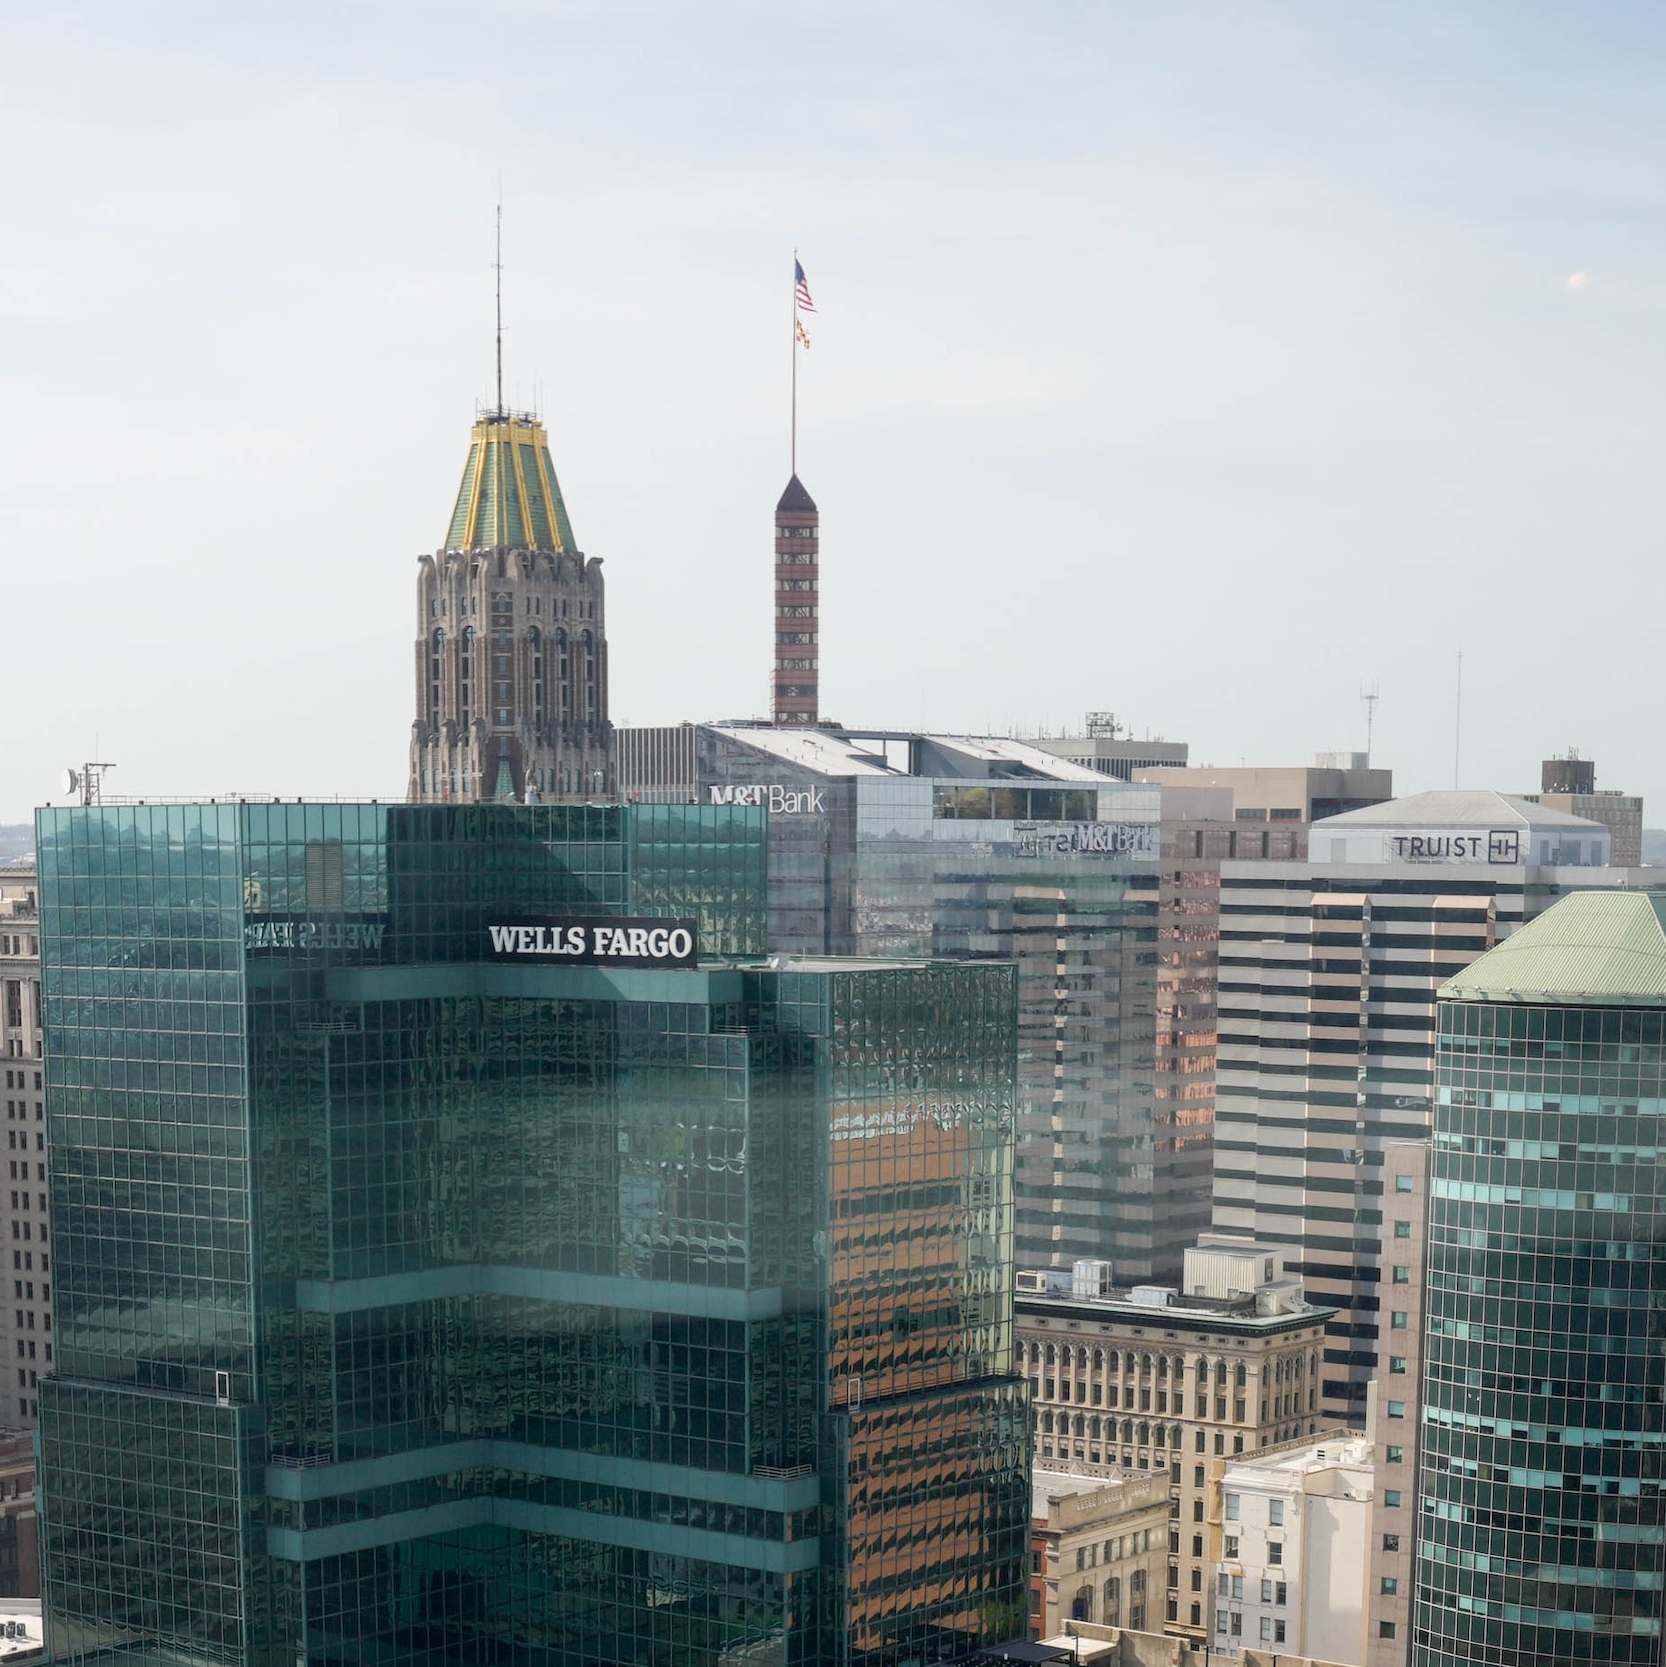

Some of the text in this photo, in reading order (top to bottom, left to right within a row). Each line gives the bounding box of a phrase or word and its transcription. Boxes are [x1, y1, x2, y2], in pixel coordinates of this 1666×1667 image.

[709, 784, 825, 813] M&T Bank
[1076, 823, 1117, 852] M&T
[1393, 837, 1482, 857] TRUIST
[488, 925, 693, 959] WELLS FARGO
